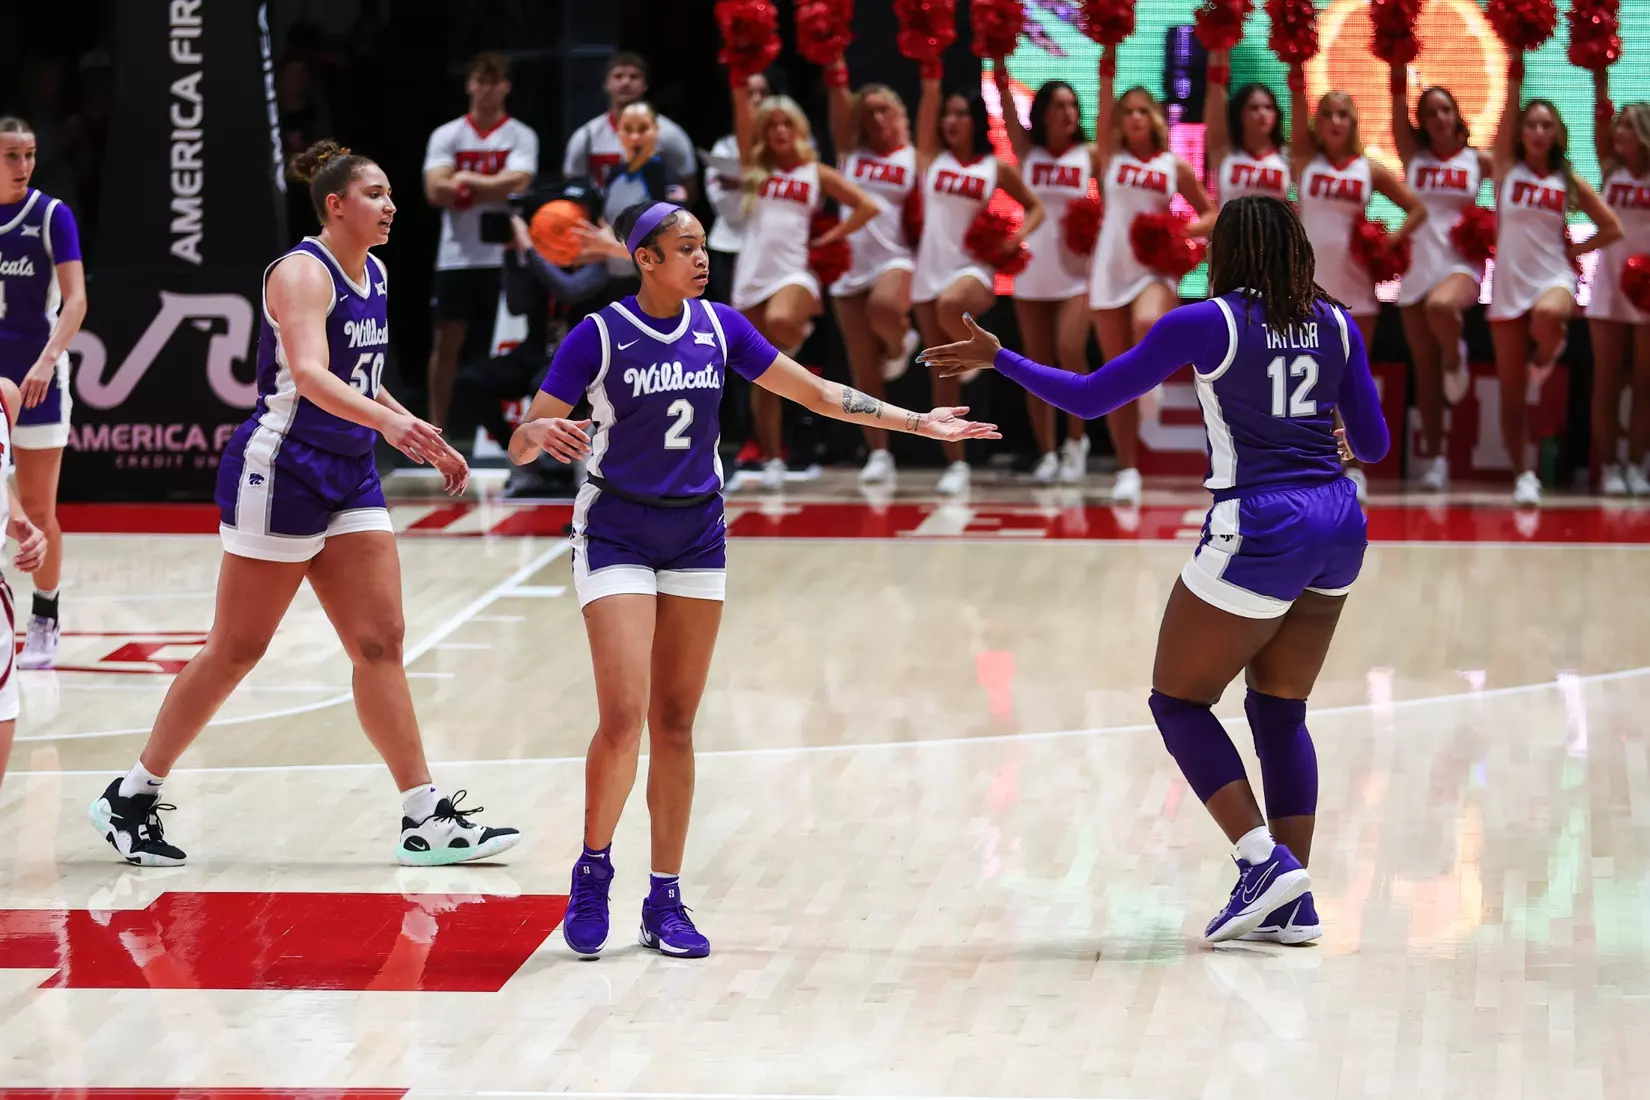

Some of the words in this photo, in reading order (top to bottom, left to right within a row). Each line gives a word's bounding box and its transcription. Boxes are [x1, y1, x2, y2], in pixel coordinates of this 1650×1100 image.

[170, 71, 203, 265] AMERICA
[349, 352, 385, 400] 50
[623, 361, 720, 398] Wildcats
[1267, 355, 1319, 418] 12
[68, 424, 208, 451] AMERICA
[664, 398, 694, 450] 2
